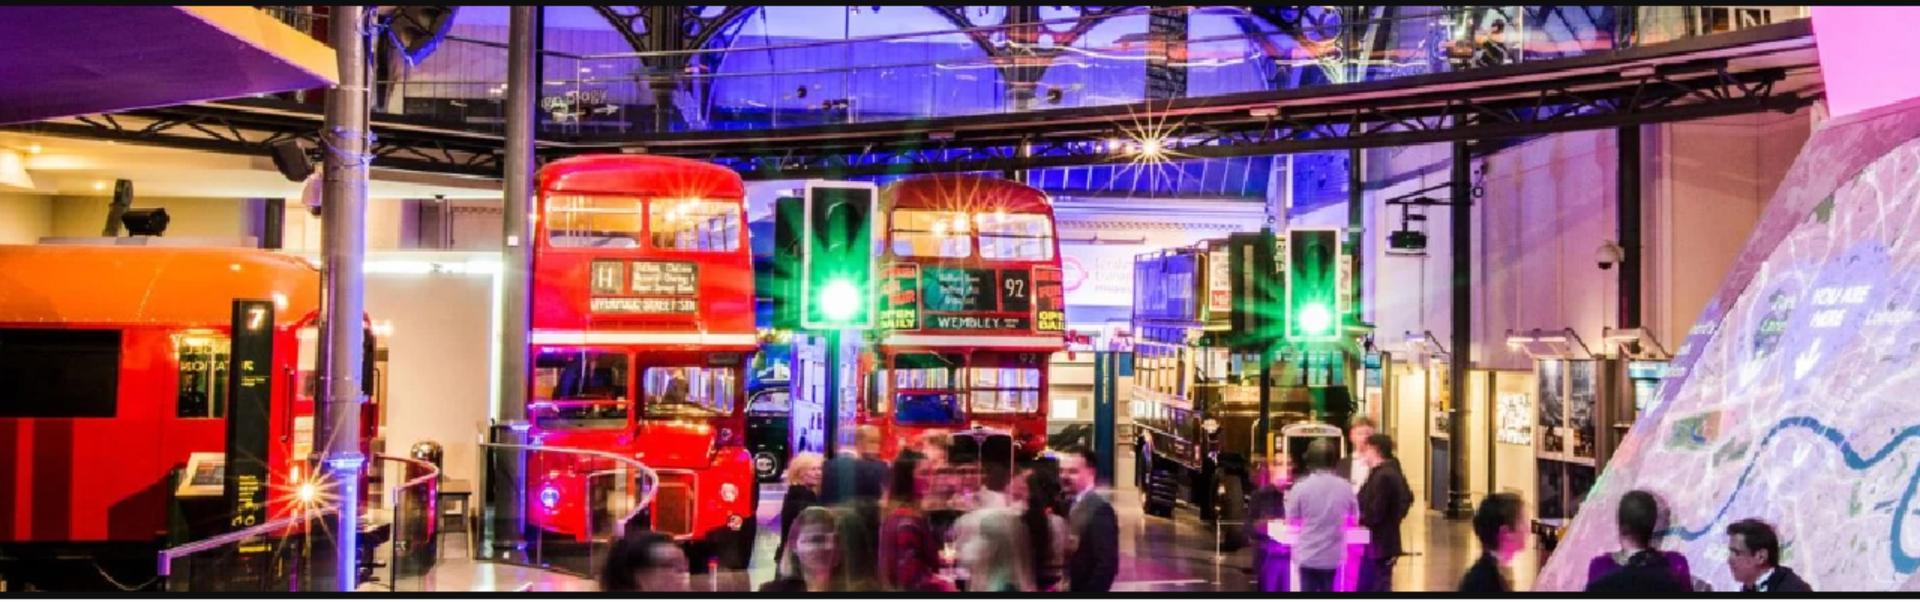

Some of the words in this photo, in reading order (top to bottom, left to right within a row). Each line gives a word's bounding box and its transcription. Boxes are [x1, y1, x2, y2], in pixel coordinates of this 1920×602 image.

[1005, 278, 1024, 298] 92
[1813, 288, 1841, 304] YOU
[247, 308, 265, 330] 7
[938, 316, 1000, 329] WEMBLEY
[1038, 311, 1064, 321] OPE
